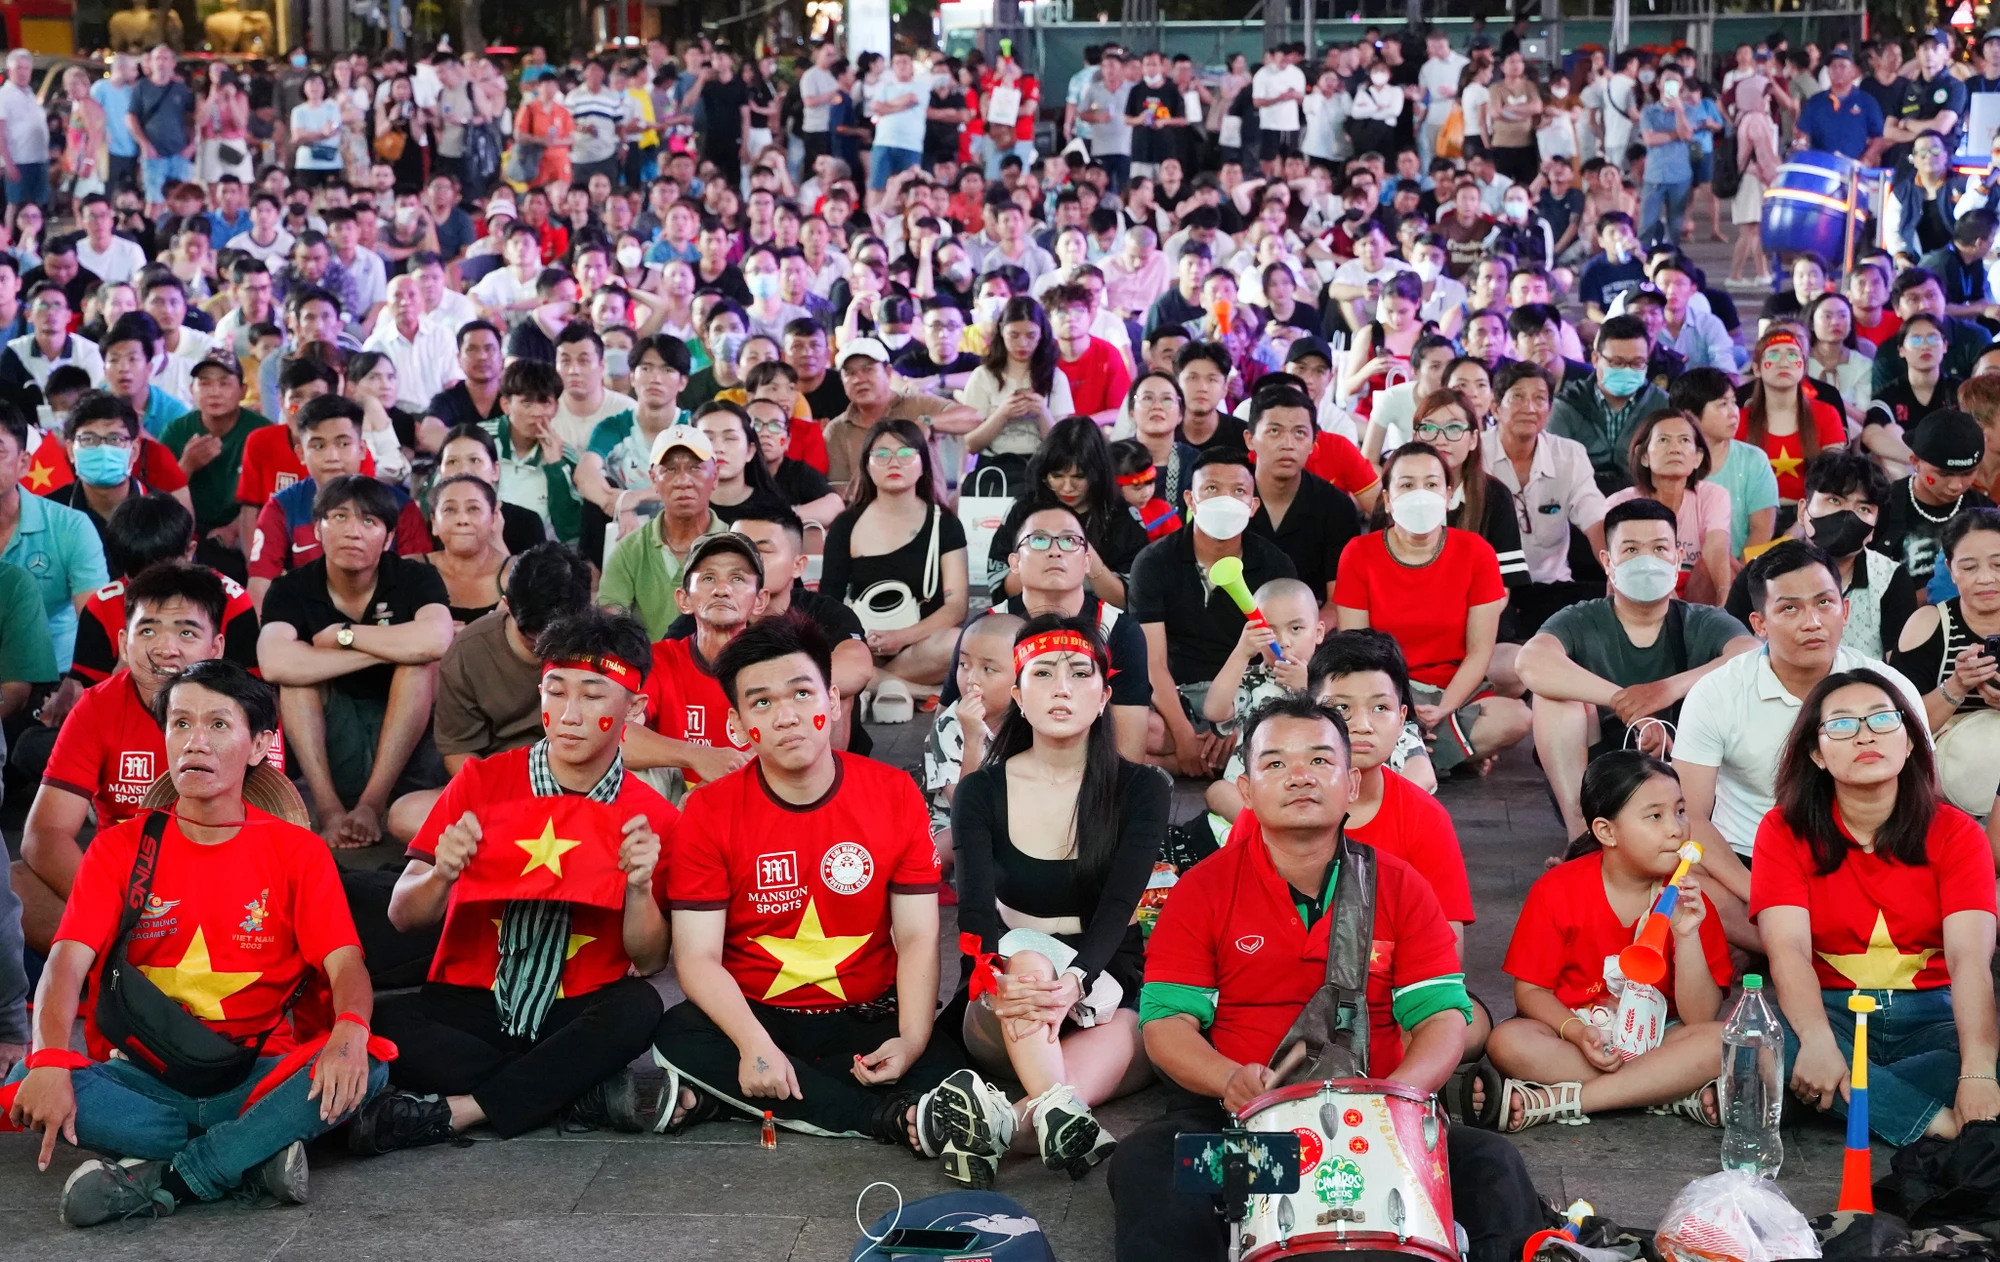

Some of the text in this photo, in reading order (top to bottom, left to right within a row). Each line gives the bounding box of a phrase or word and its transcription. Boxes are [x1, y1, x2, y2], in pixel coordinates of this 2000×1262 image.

[129, 834, 157, 909] STING
[748, 886, 809, 902] MANSION
[756, 899, 802, 914] SPORTS
[231, 934, 253, 942] VIET
[240, 942, 262, 950] 2003
[1298, 1128, 1321, 1147] FOOTBALL
